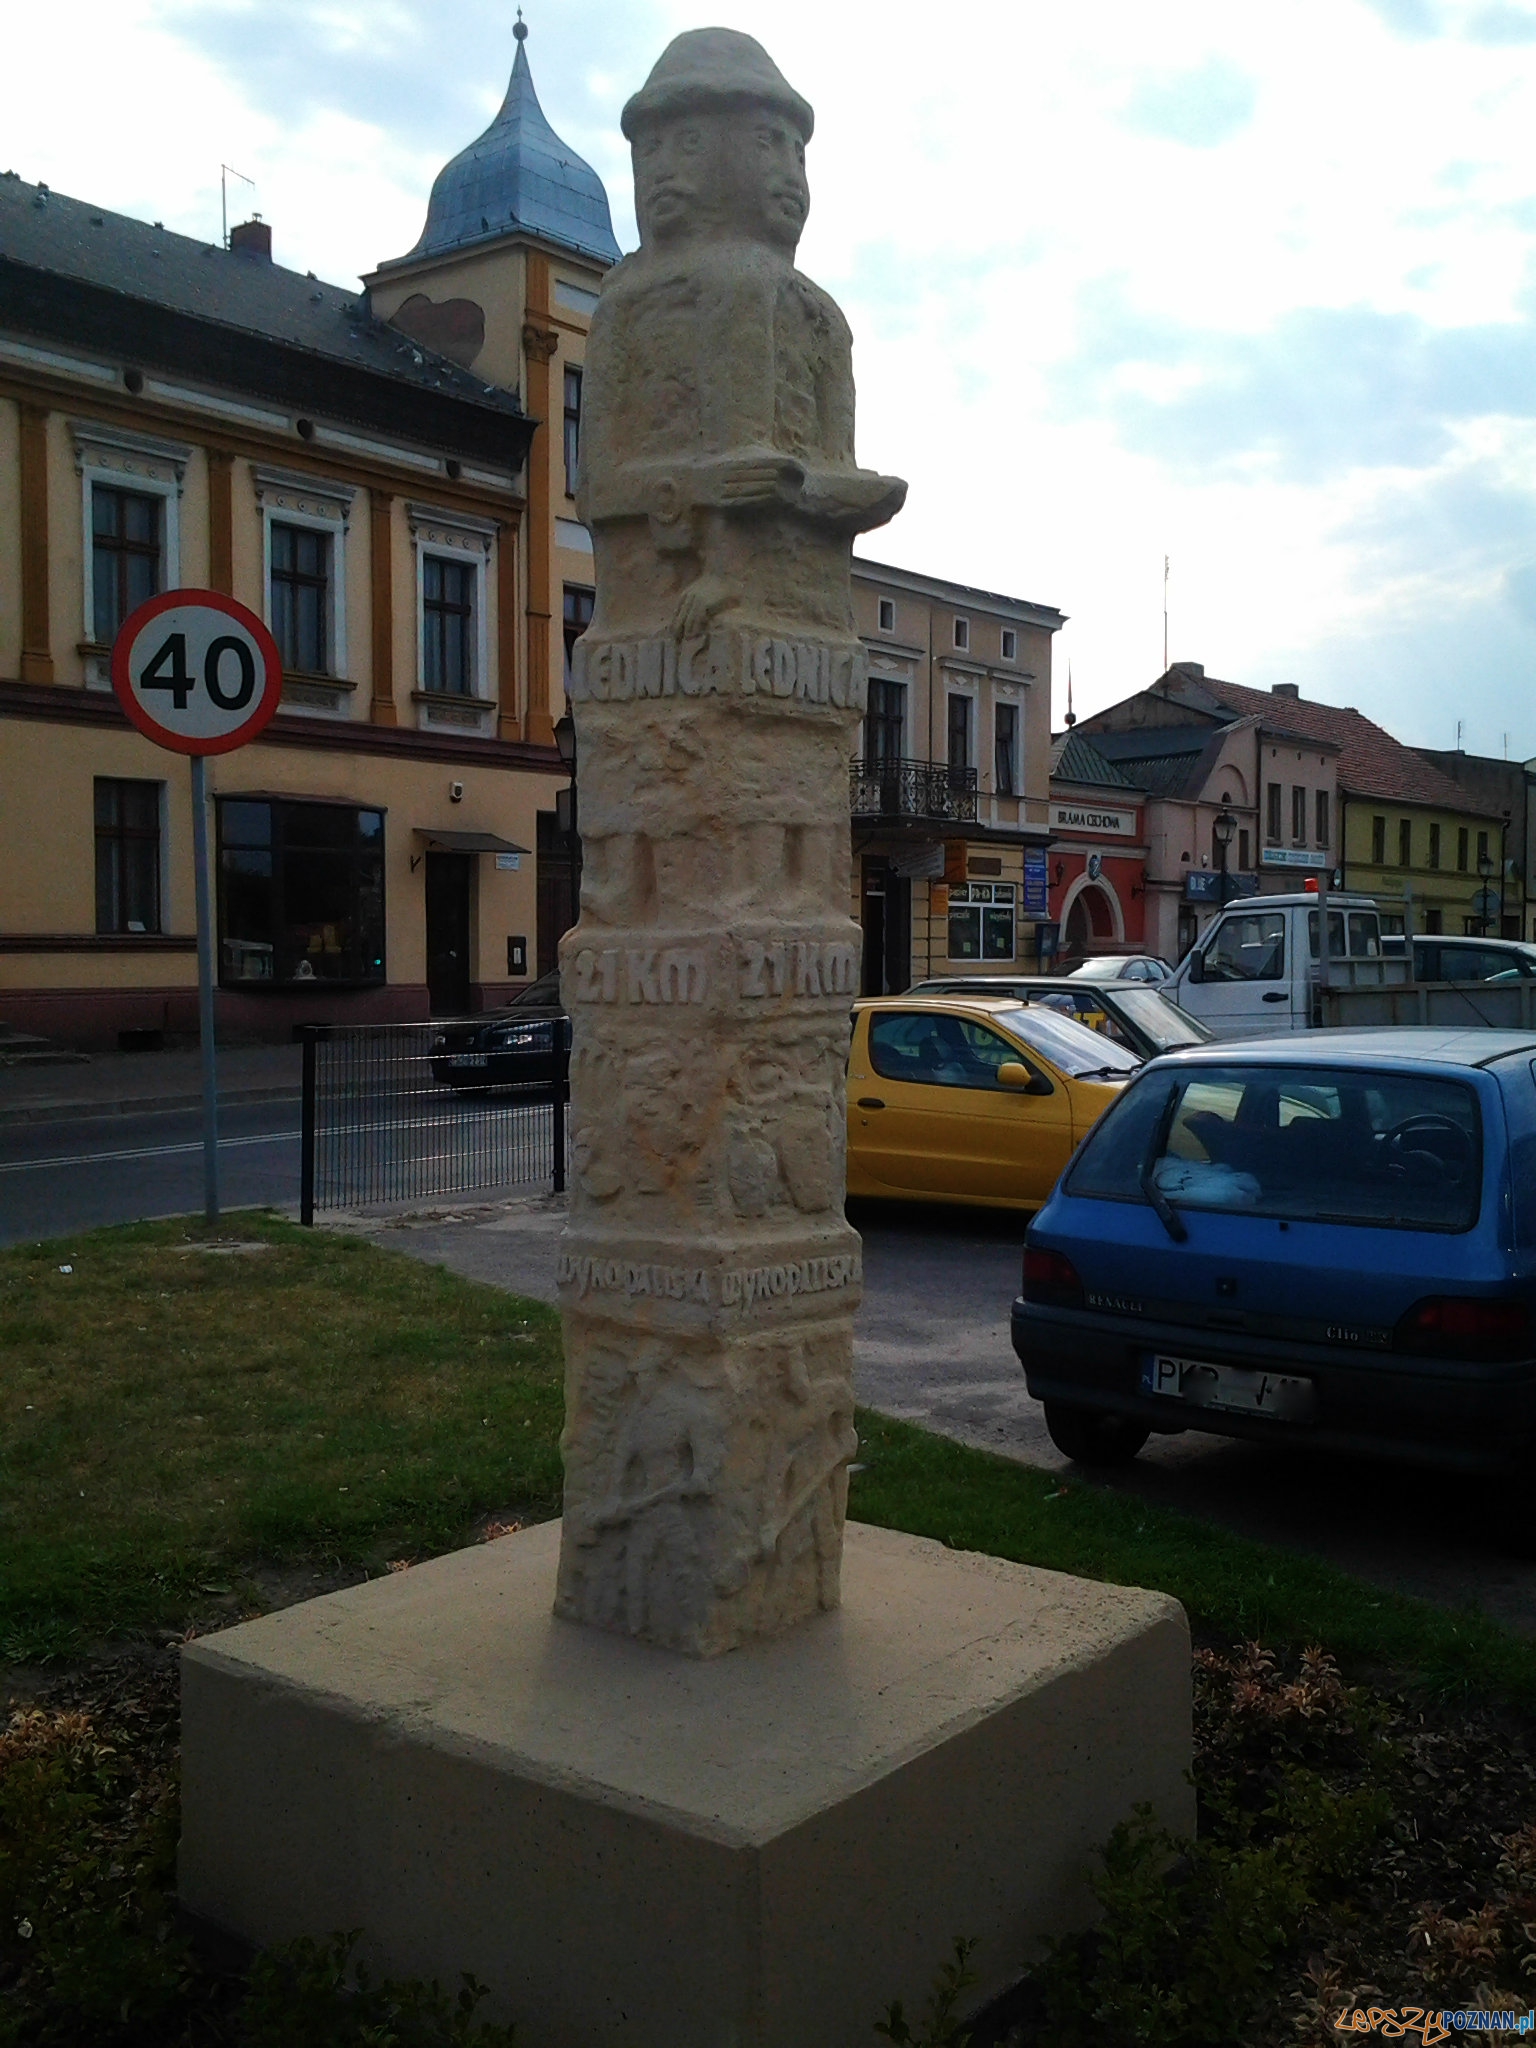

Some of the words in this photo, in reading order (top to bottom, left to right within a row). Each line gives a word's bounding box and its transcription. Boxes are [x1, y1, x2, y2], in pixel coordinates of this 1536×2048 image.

[140, 632, 256, 711] 40
[1058, 811, 1085, 826] BRAMA
[576, 948, 619, 1004] 21
[1088, 1295, 1142, 1312] RENAULT
[1326, 1325, 1359, 1342] Clio
